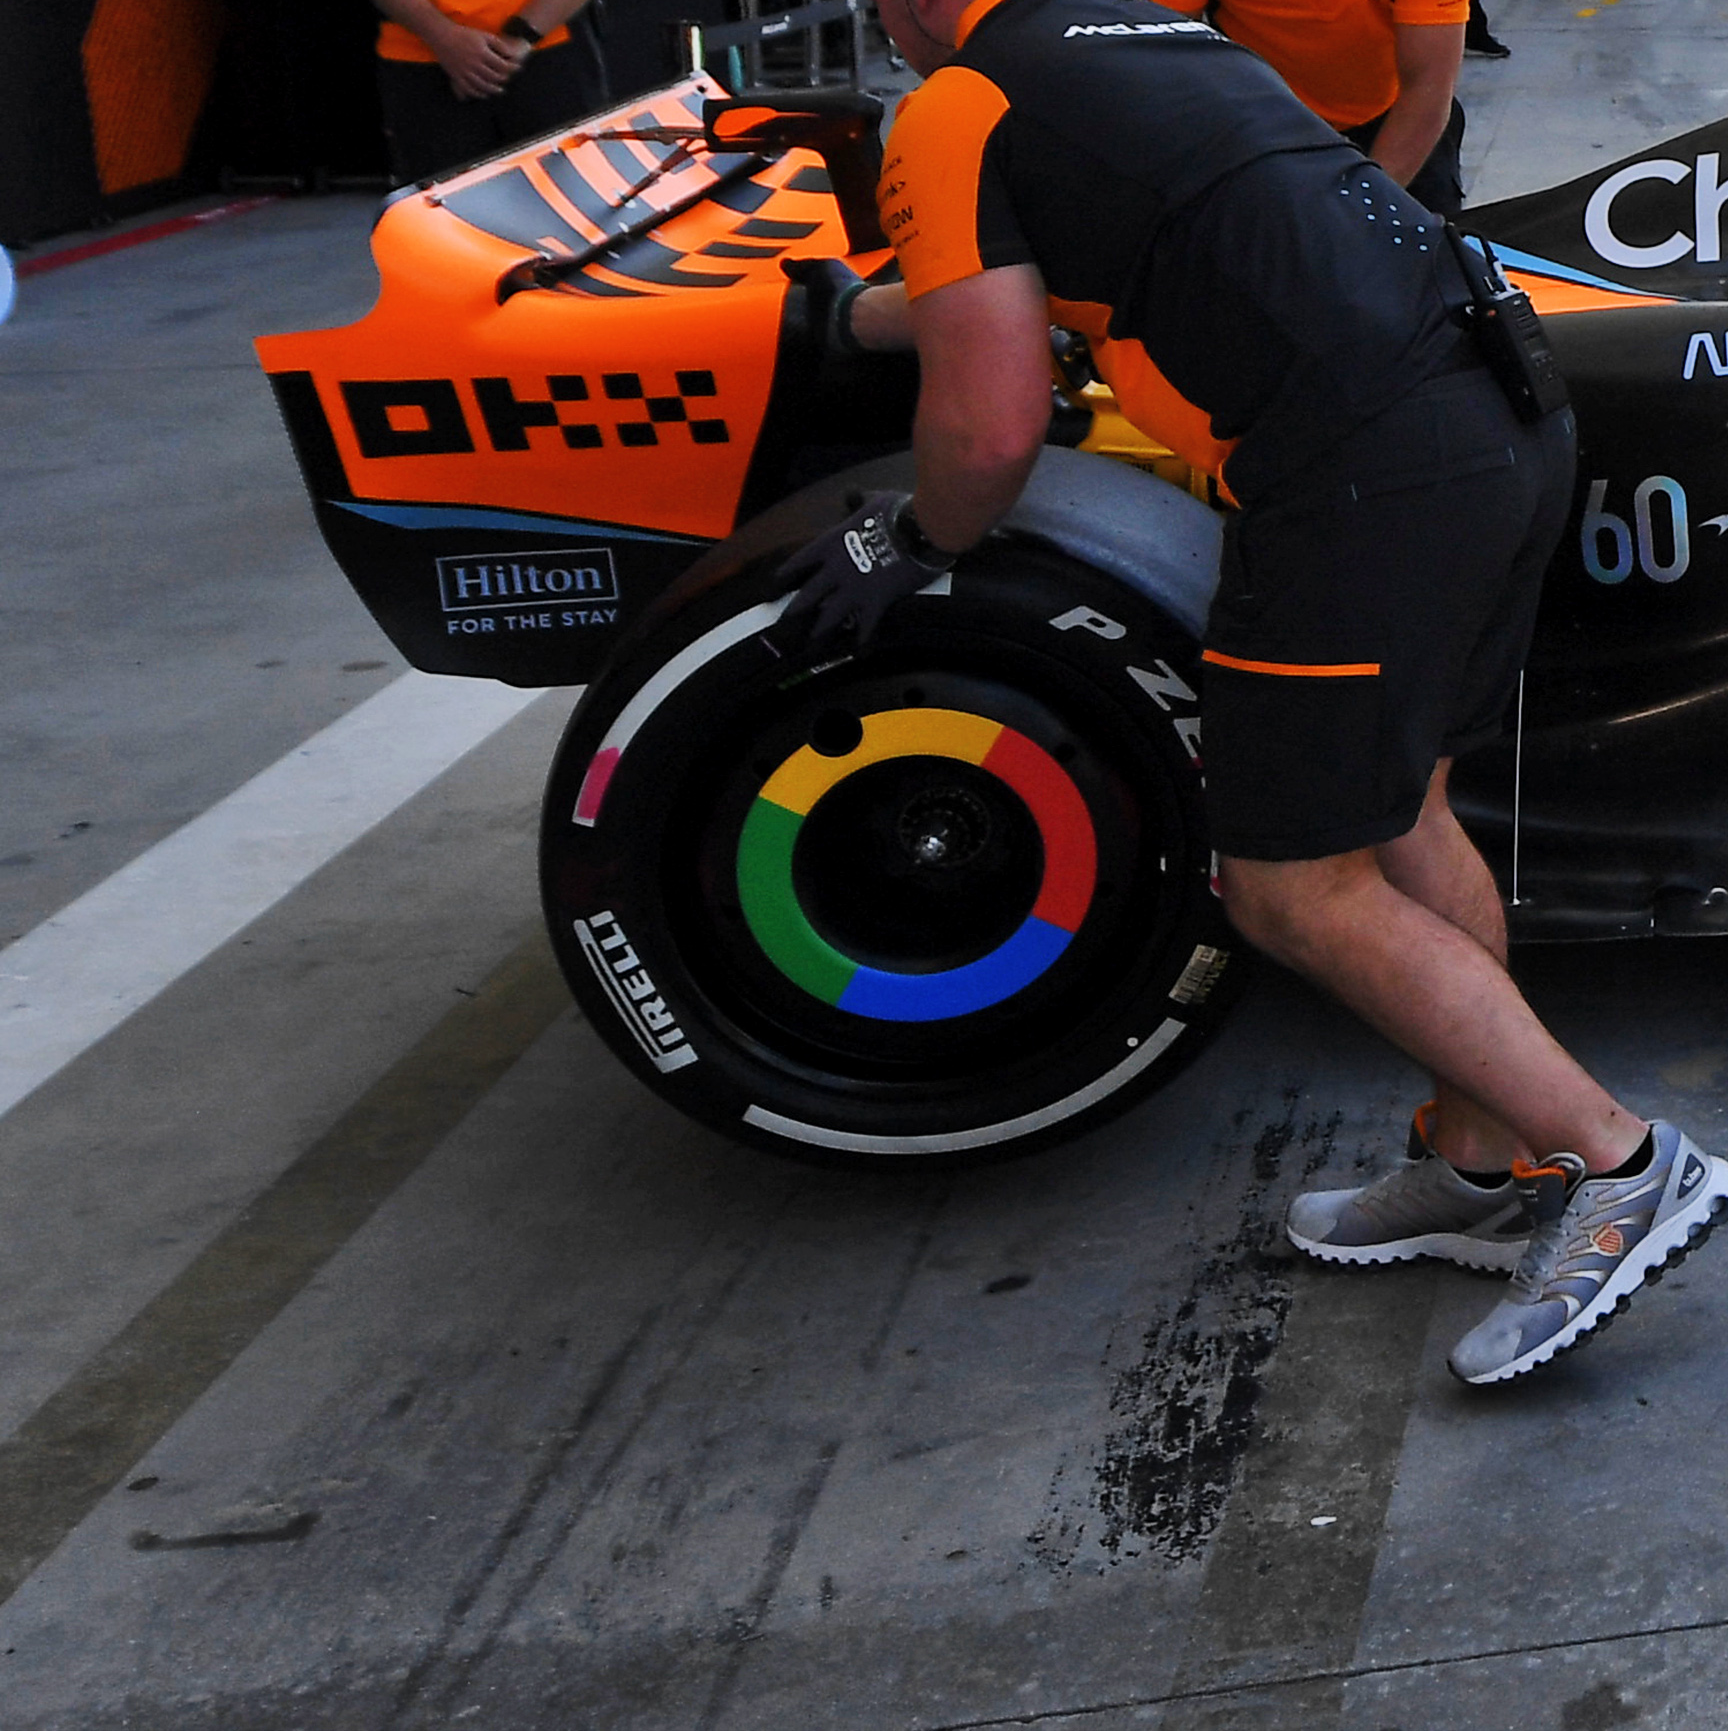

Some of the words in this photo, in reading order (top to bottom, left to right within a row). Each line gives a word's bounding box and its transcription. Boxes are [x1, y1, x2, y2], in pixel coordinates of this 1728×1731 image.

[1063, 21, 1217, 38] McLaren
[339, 370, 730, 459] OKX
[1581, 475, 1690, 584] 60
[454, 564, 602, 598] Hilton
[448, 618, 495, 634] FOR
[504, 613, 552, 630] THE
[562, 609, 617, 626] STAY
